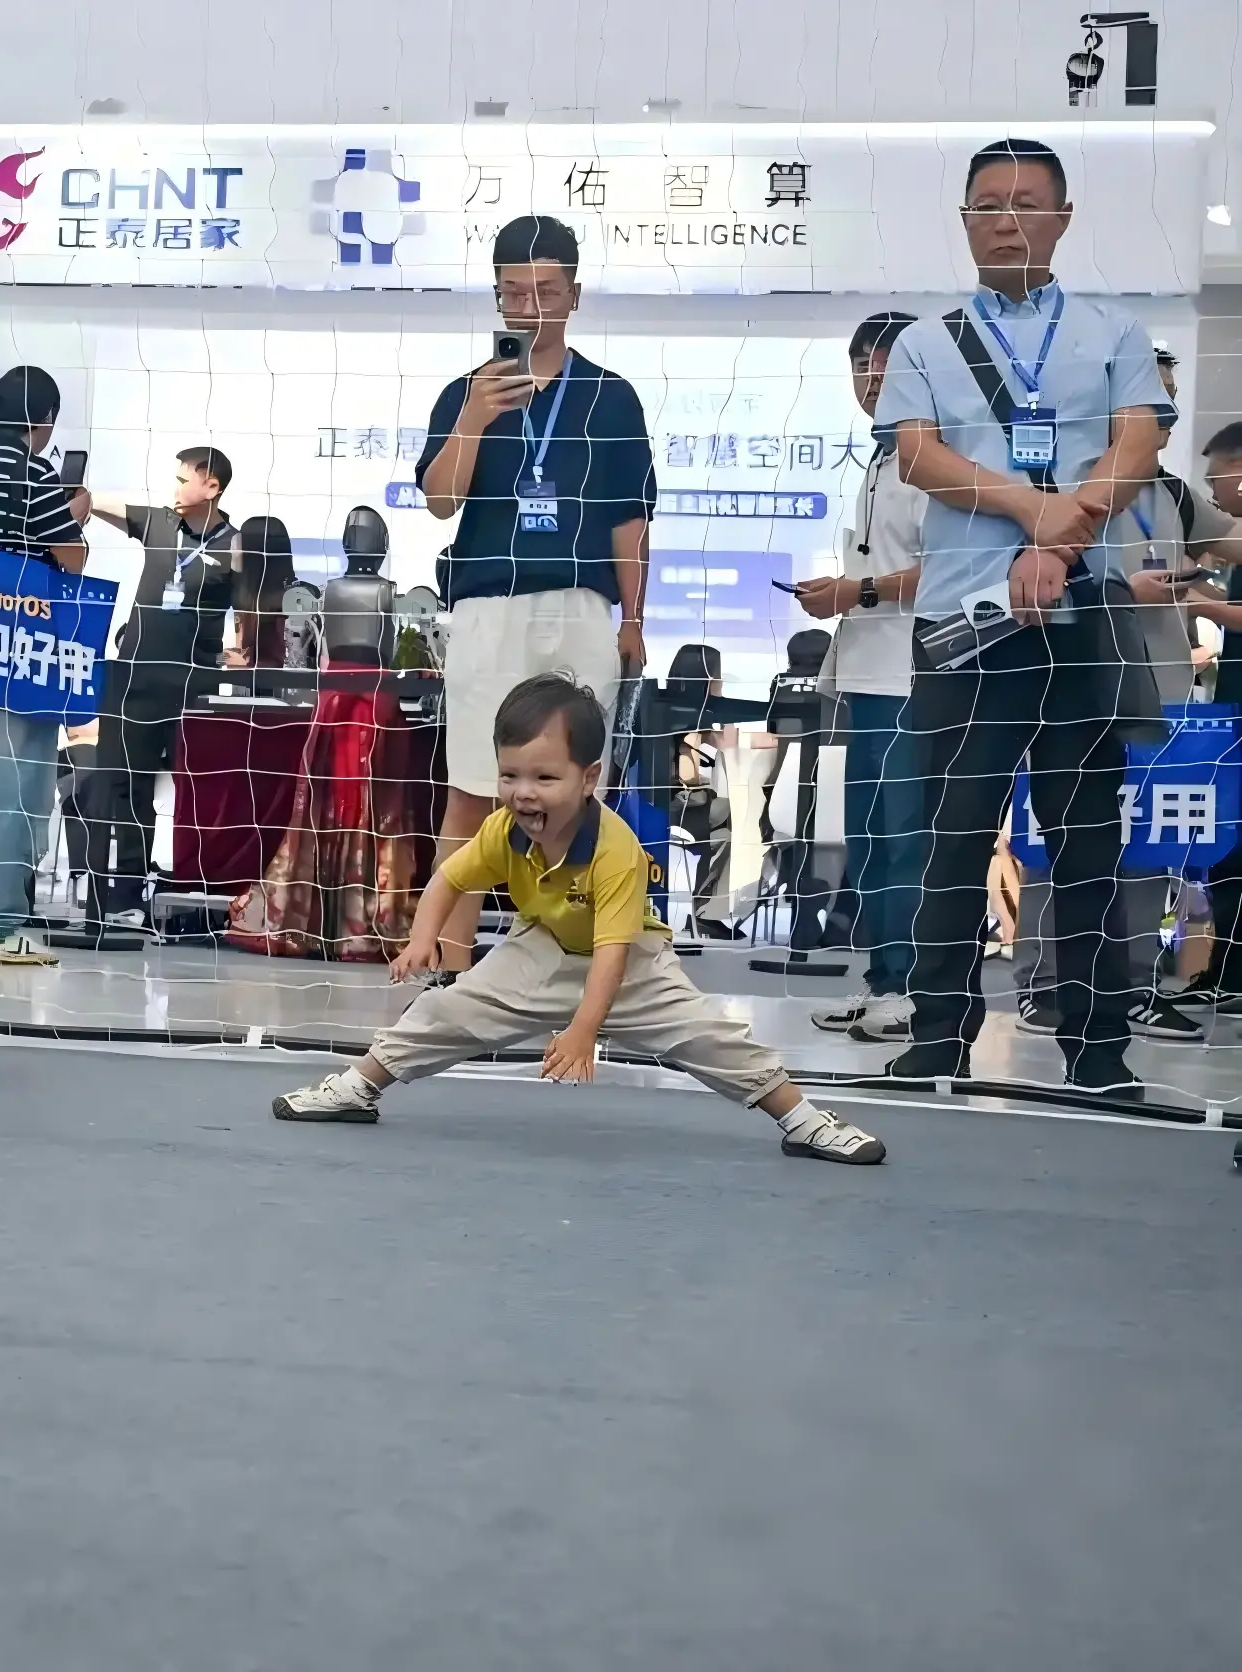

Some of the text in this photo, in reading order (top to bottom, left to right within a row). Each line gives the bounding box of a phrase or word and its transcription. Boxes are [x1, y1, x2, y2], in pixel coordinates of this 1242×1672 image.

[61, 168, 243, 210] CHNT
[465, 161, 812, 208] 万佑智算
[58, 217, 243, 250] 正泰居家
[608, 223, 807, 246] INTELLIGENCE
